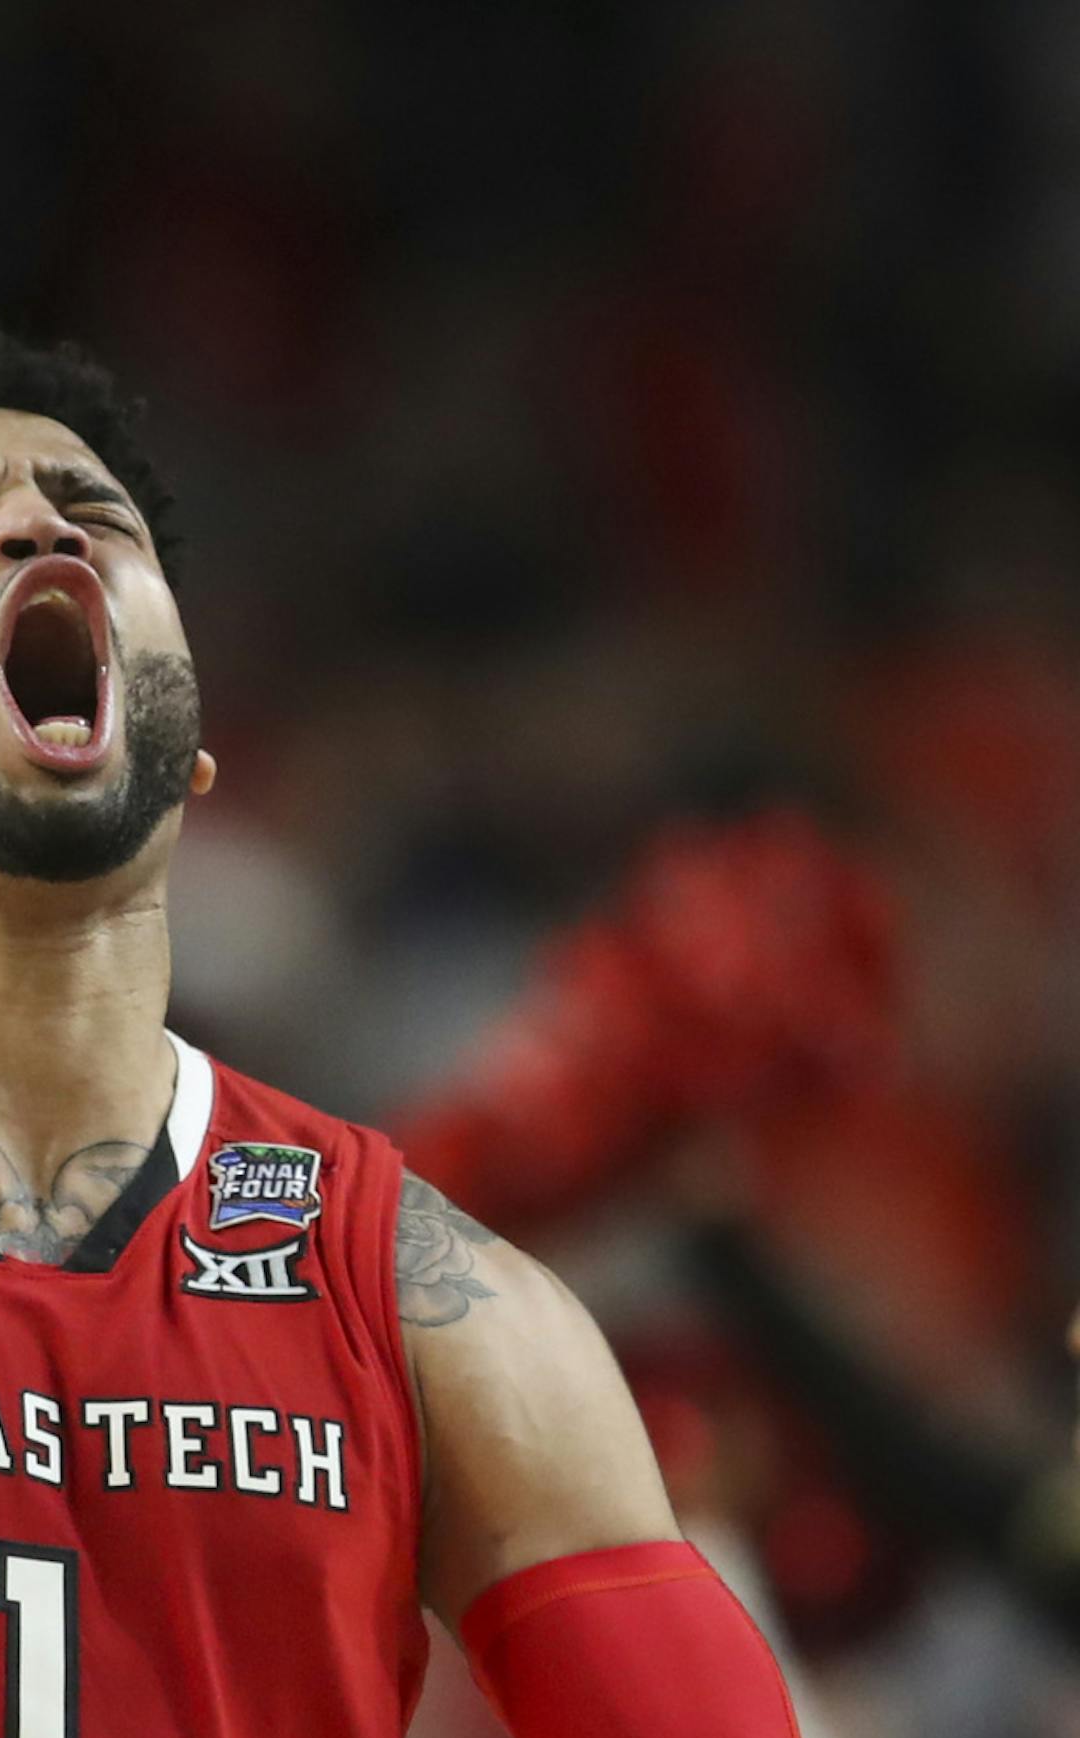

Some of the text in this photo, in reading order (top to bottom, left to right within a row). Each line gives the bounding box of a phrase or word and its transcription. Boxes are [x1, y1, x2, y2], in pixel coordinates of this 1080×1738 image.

[223, 1180, 305, 1199] FOUR
[226, 1162, 308, 1181] FINAL
[183, 1235, 308, 1295] XII
[81, 1398, 348, 1510] TECH
